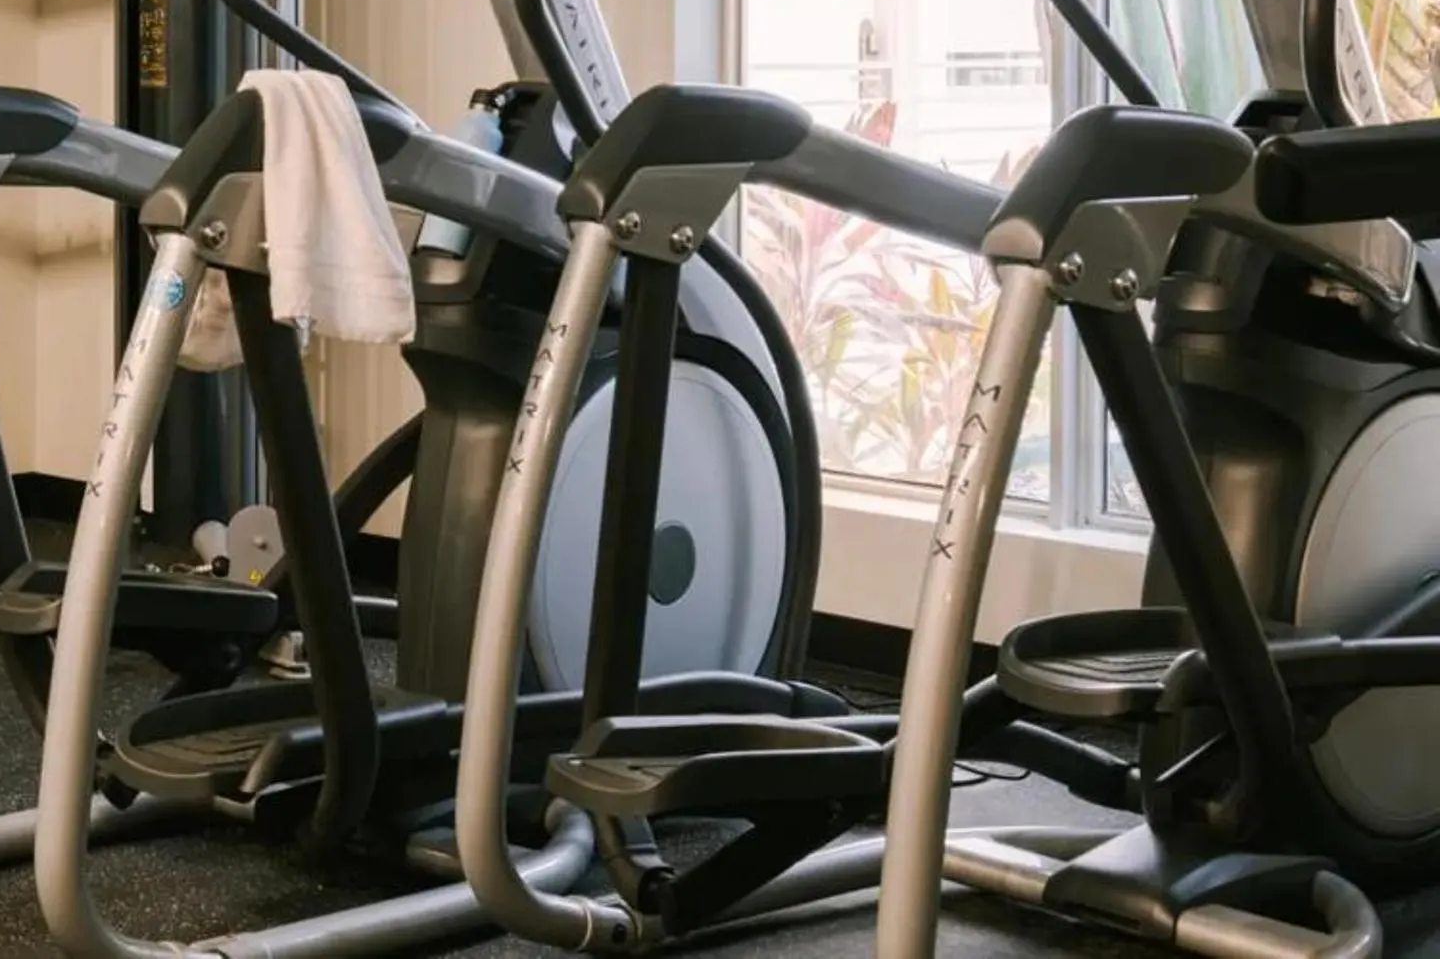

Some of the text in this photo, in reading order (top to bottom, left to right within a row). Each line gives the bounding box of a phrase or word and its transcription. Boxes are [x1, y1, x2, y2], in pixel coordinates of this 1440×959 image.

[86, 338, 147, 498] MATRIX
[509, 320, 569, 473] MATRIX
[932, 381, 1002, 560] MATRIX
